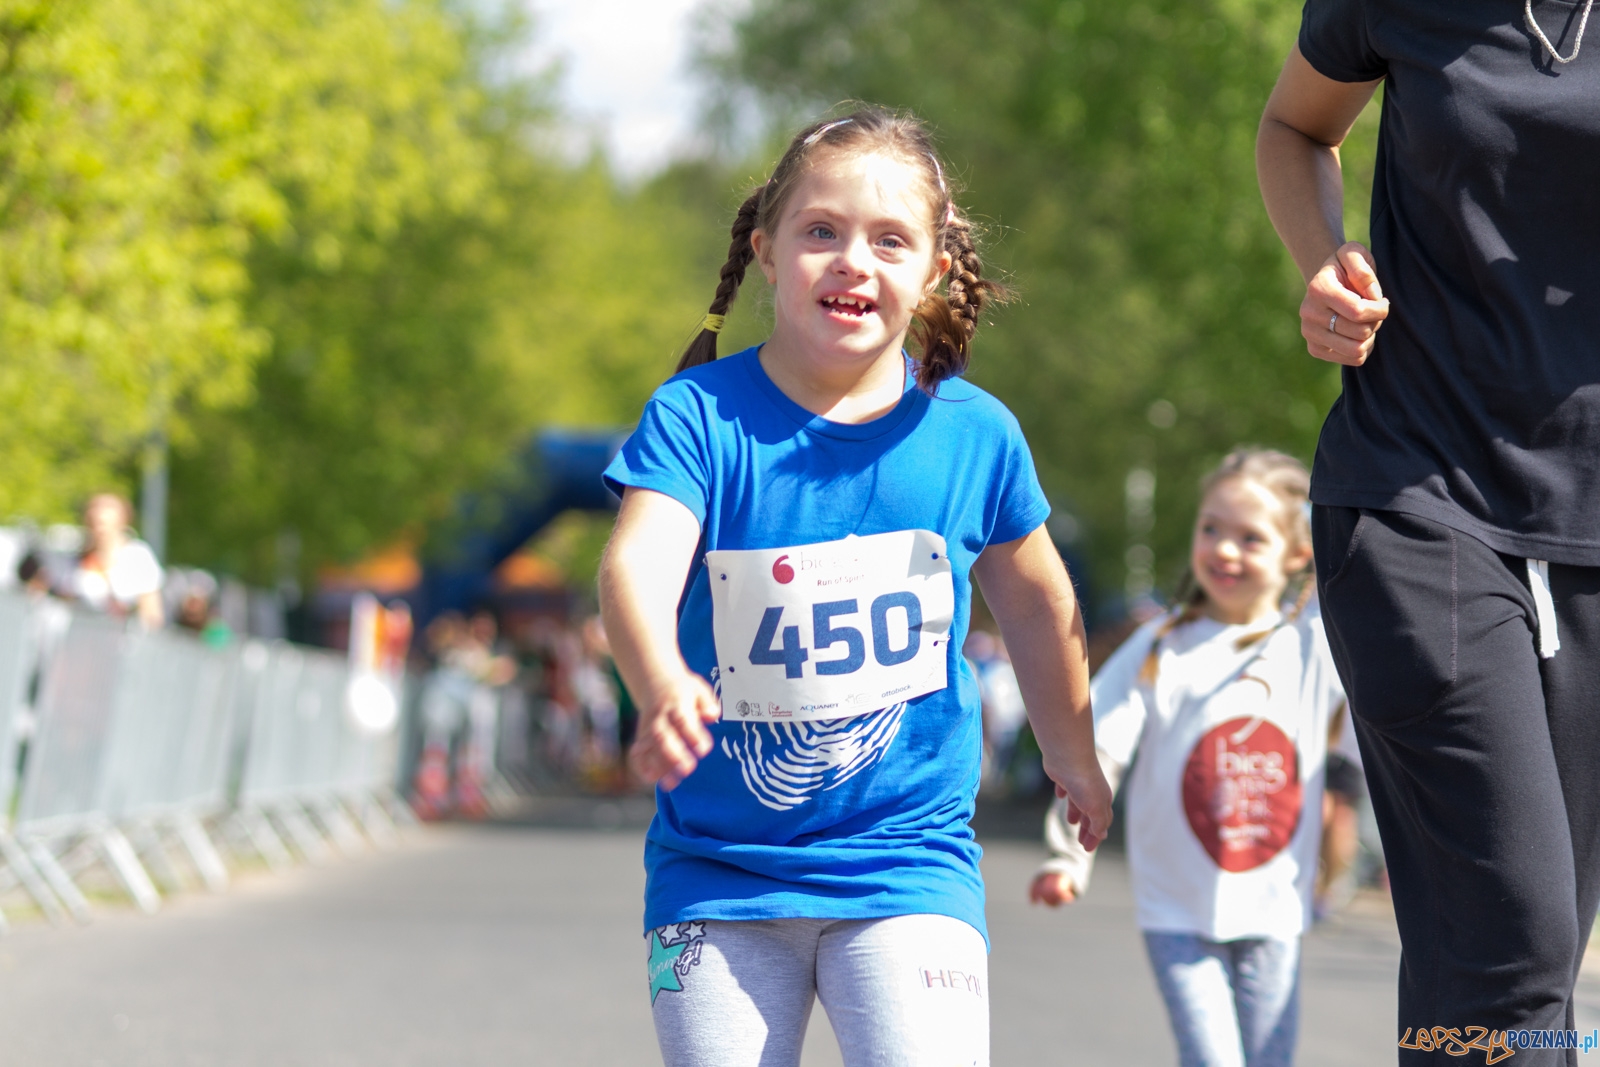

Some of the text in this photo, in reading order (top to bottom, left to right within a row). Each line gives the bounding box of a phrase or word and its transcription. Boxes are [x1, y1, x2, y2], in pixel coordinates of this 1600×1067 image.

[817, 578, 833, 587] Run
[834, 576, 842, 585] of
[748, 590, 922, 680] 450
